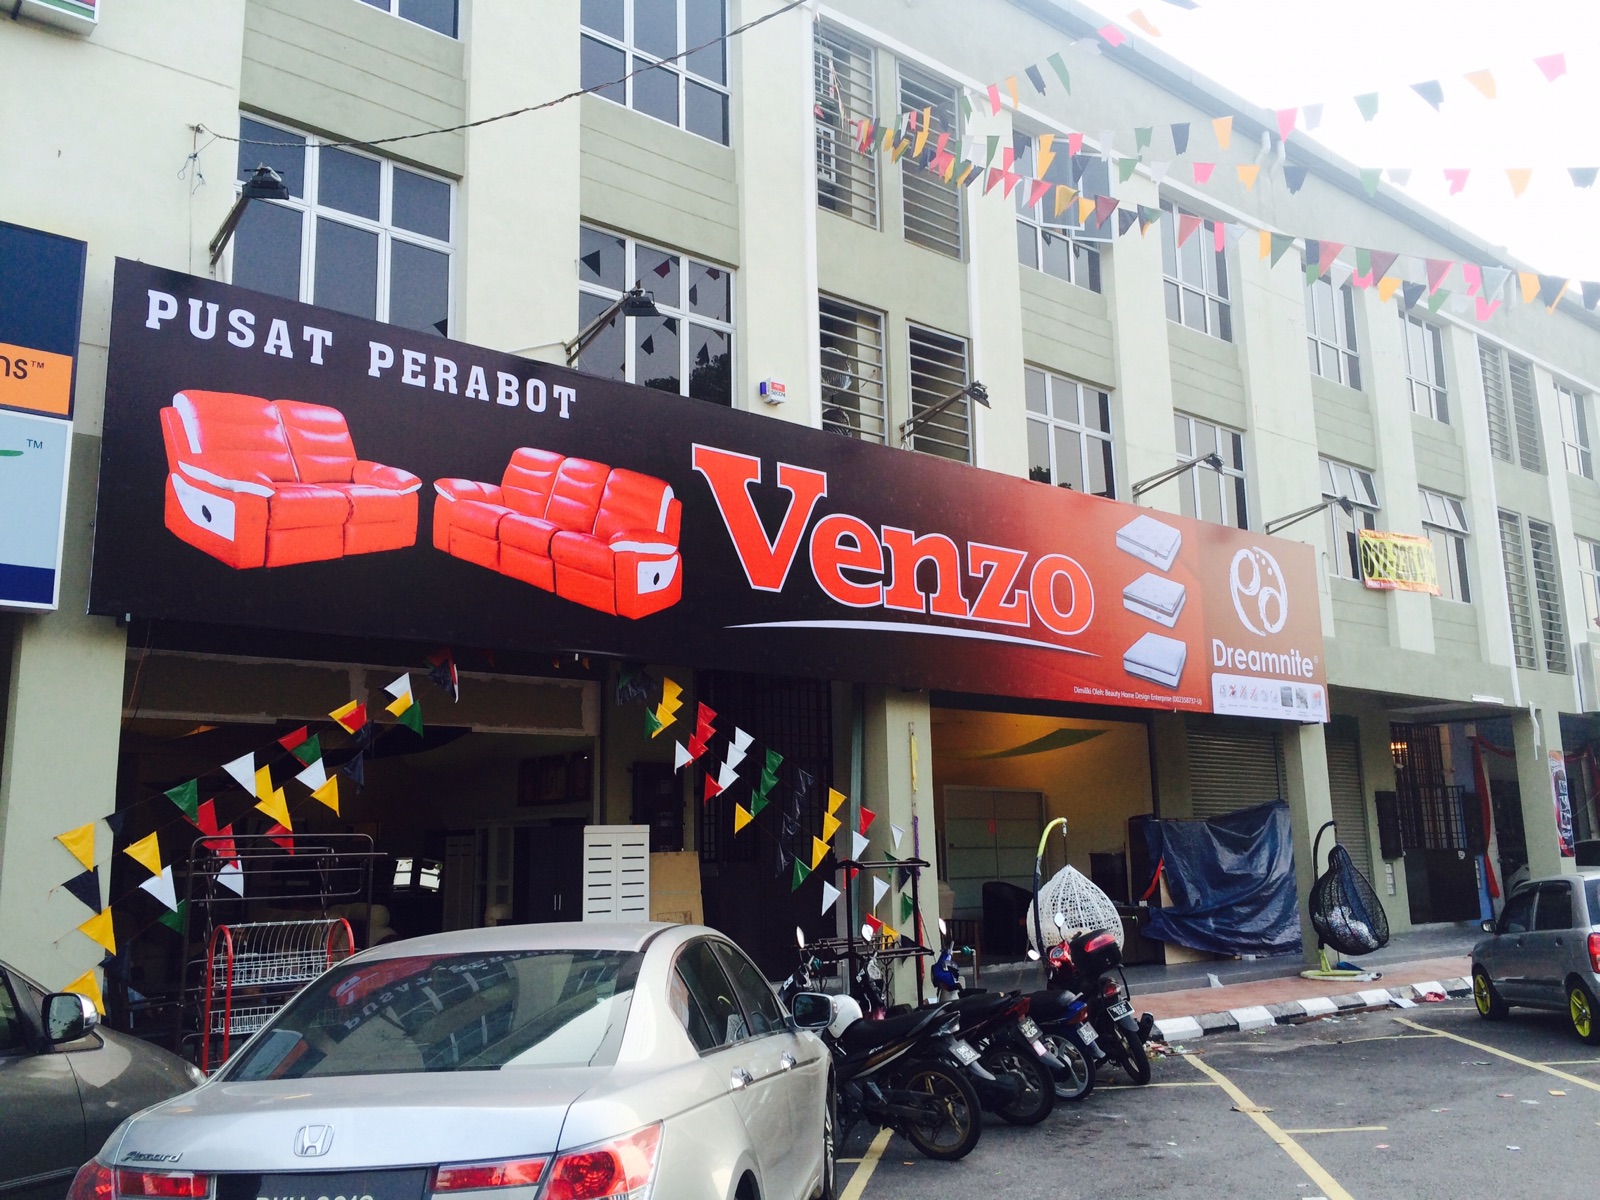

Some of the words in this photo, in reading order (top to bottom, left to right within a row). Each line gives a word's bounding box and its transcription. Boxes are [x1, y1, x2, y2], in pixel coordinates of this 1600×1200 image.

[145, 288, 334, 366] PUSAT
[367, 340, 578, 420] PERABOT
[691, 442, 1096, 636] Venzo
[1105, 689, 1121, 699] Beauty
[1121, 690, 1135, 699] Home
[1135, 692, 1151, 702] Design
[1151, 693, 1172, 703] Enterprise
[1212, 638, 1314, 678] Dreamnite
